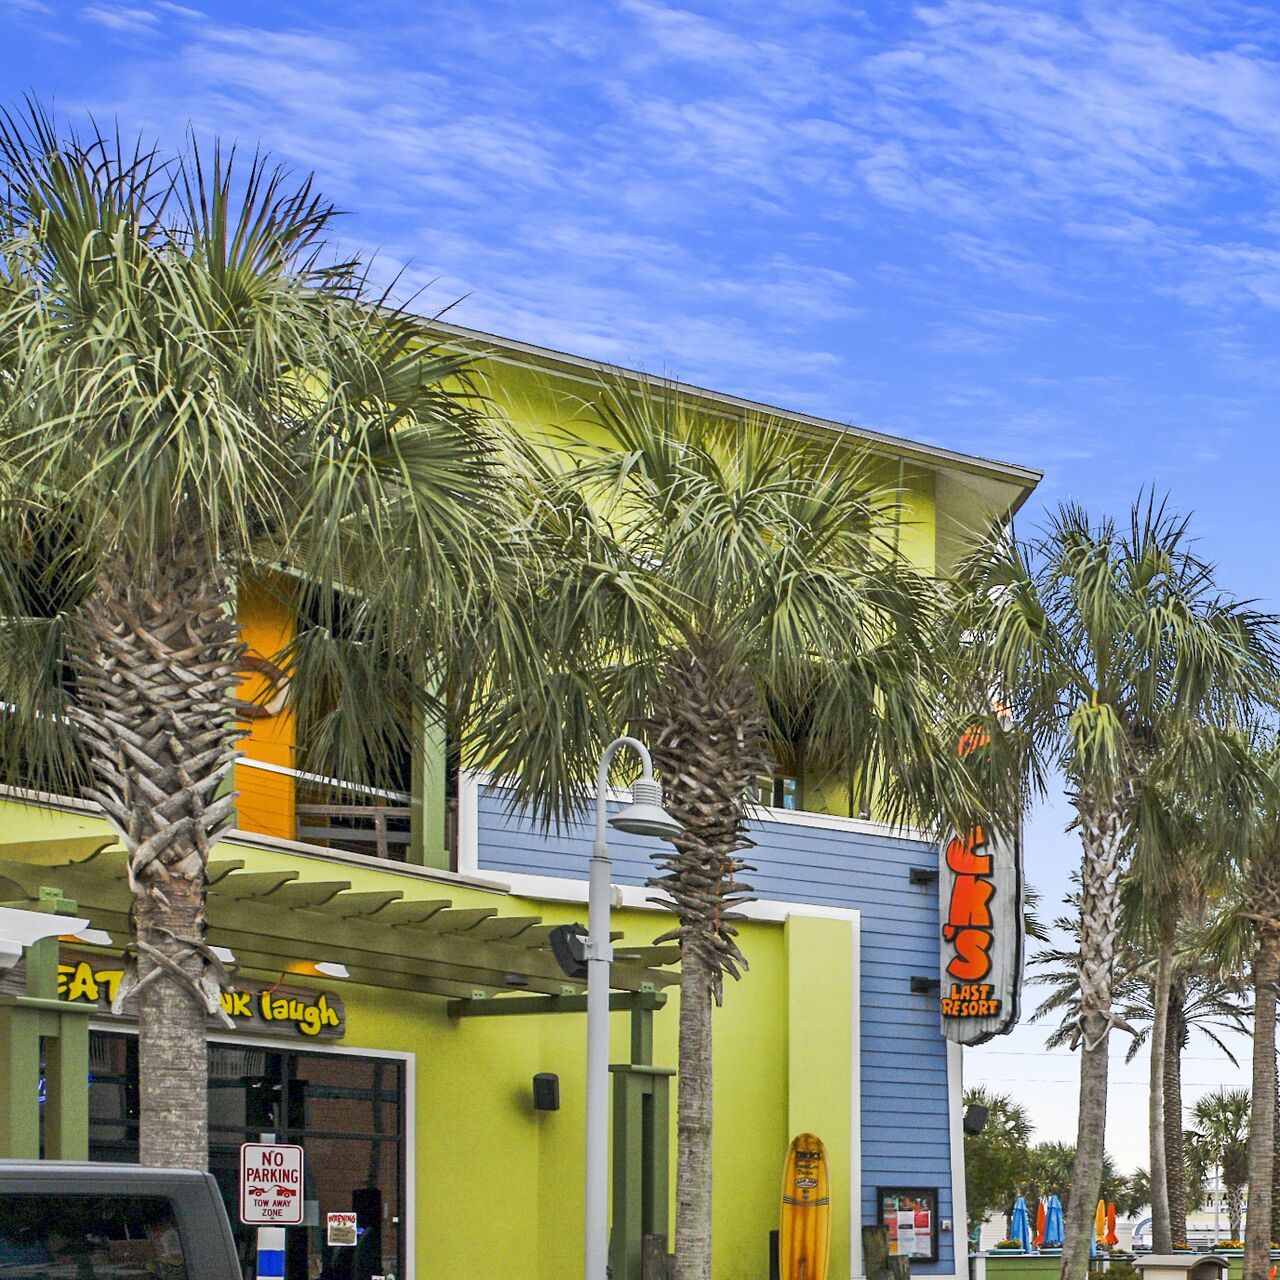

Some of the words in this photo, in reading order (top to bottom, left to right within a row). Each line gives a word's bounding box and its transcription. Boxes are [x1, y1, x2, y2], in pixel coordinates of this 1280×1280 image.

[951, 984, 990, 1000] LAST
[261, 991, 340, 1035] laugh
[941, 999, 998, 1016] RESORT
[262, 1152, 284, 1166] NO
[246, 1168, 299, 1183] PARKING
[254, 1199, 269, 1207] TOW
[329, 1215, 356, 1223] WARNING
